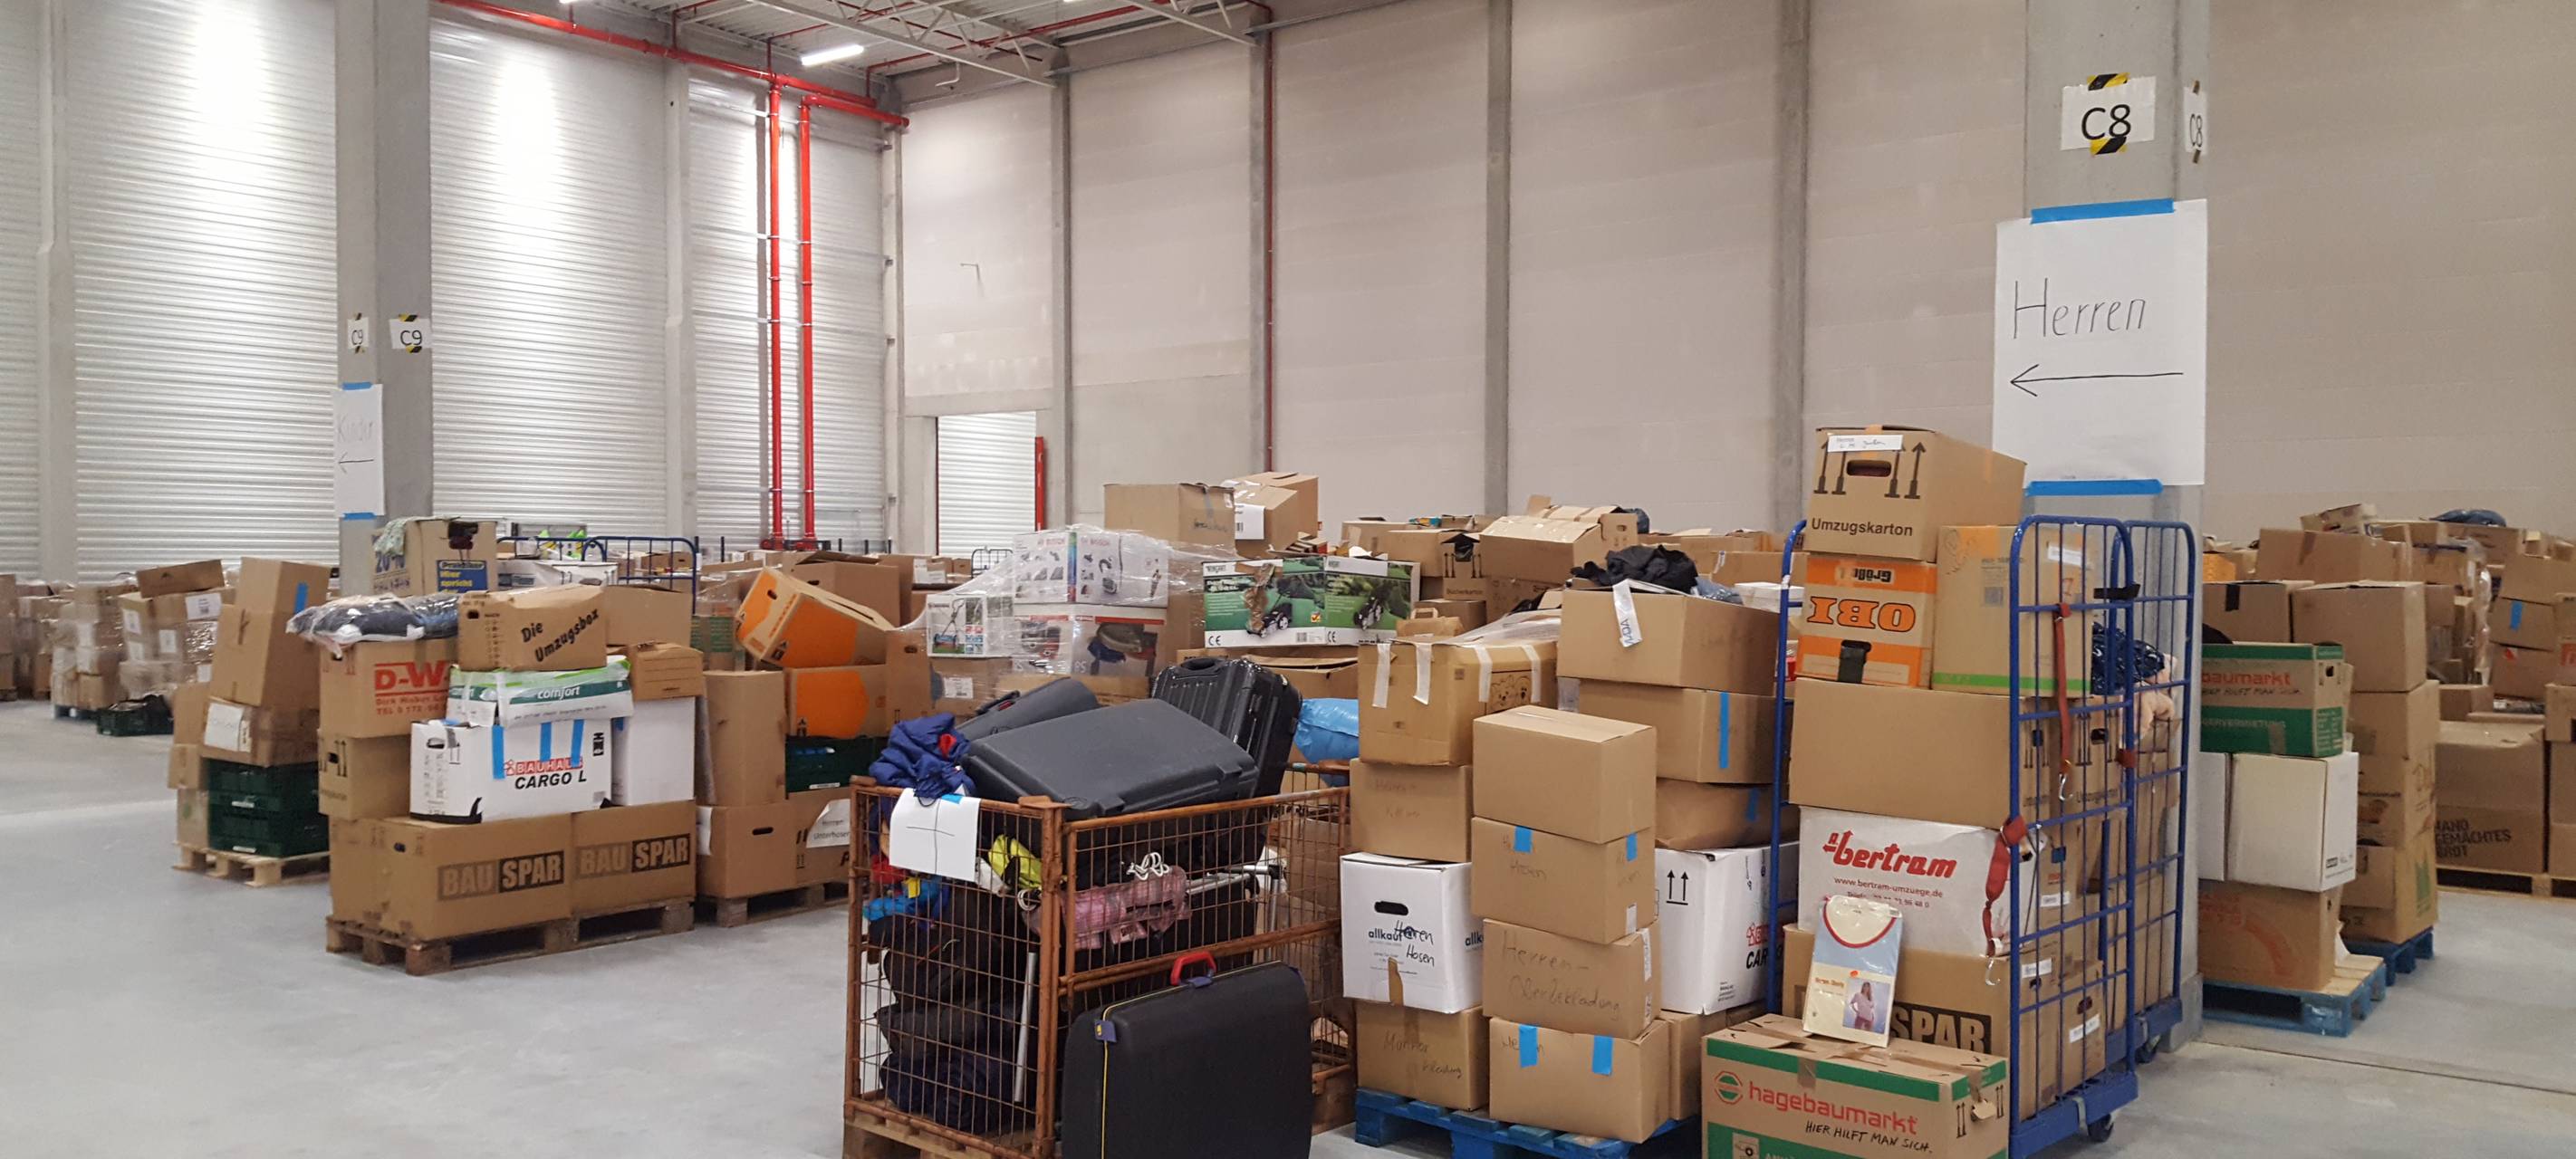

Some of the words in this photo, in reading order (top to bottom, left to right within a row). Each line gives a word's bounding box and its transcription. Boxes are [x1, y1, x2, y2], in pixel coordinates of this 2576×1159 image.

[2081, 104, 2131, 140] C8
[2189, 113, 2203, 148] C8
[2013, 277, 2147, 340] Herren
[351, 330, 363, 346] C9
[400, 330, 423, 346] C9
[1812, 518, 1914, 537] Umzugskarton
[520, 620, 543, 643] Die
[1807, 596, 1917, 632] OBI
[533, 608, 601, 663] Umzugsbox
[514, 772, 572, 790] CARGO
[578, 768, 587, 782] L
[580, 846, 627, 876] BAU
[635, 836, 690, 870] SPAR
[1831, 830, 1957, 878] bertram
[443, 866, 493, 896] BAU
[501, 853, 563, 889] SPAR
[1833, 876, 1944, 898] www.bertram-umzuege.de
[1406, 943, 1435, 967] Hosen
[1892, 1006, 1985, 1055] SPAR
[1750, 1080, 1918, 1135] hagebaumarkt
[1805, 1120, 1831, 1135] HIER
[1833, 1127, 1869, 1145] HILFT
[1870, 1132, 1899, 1147] MAN
[1901, 1138, 1933, 1154] SICH.
